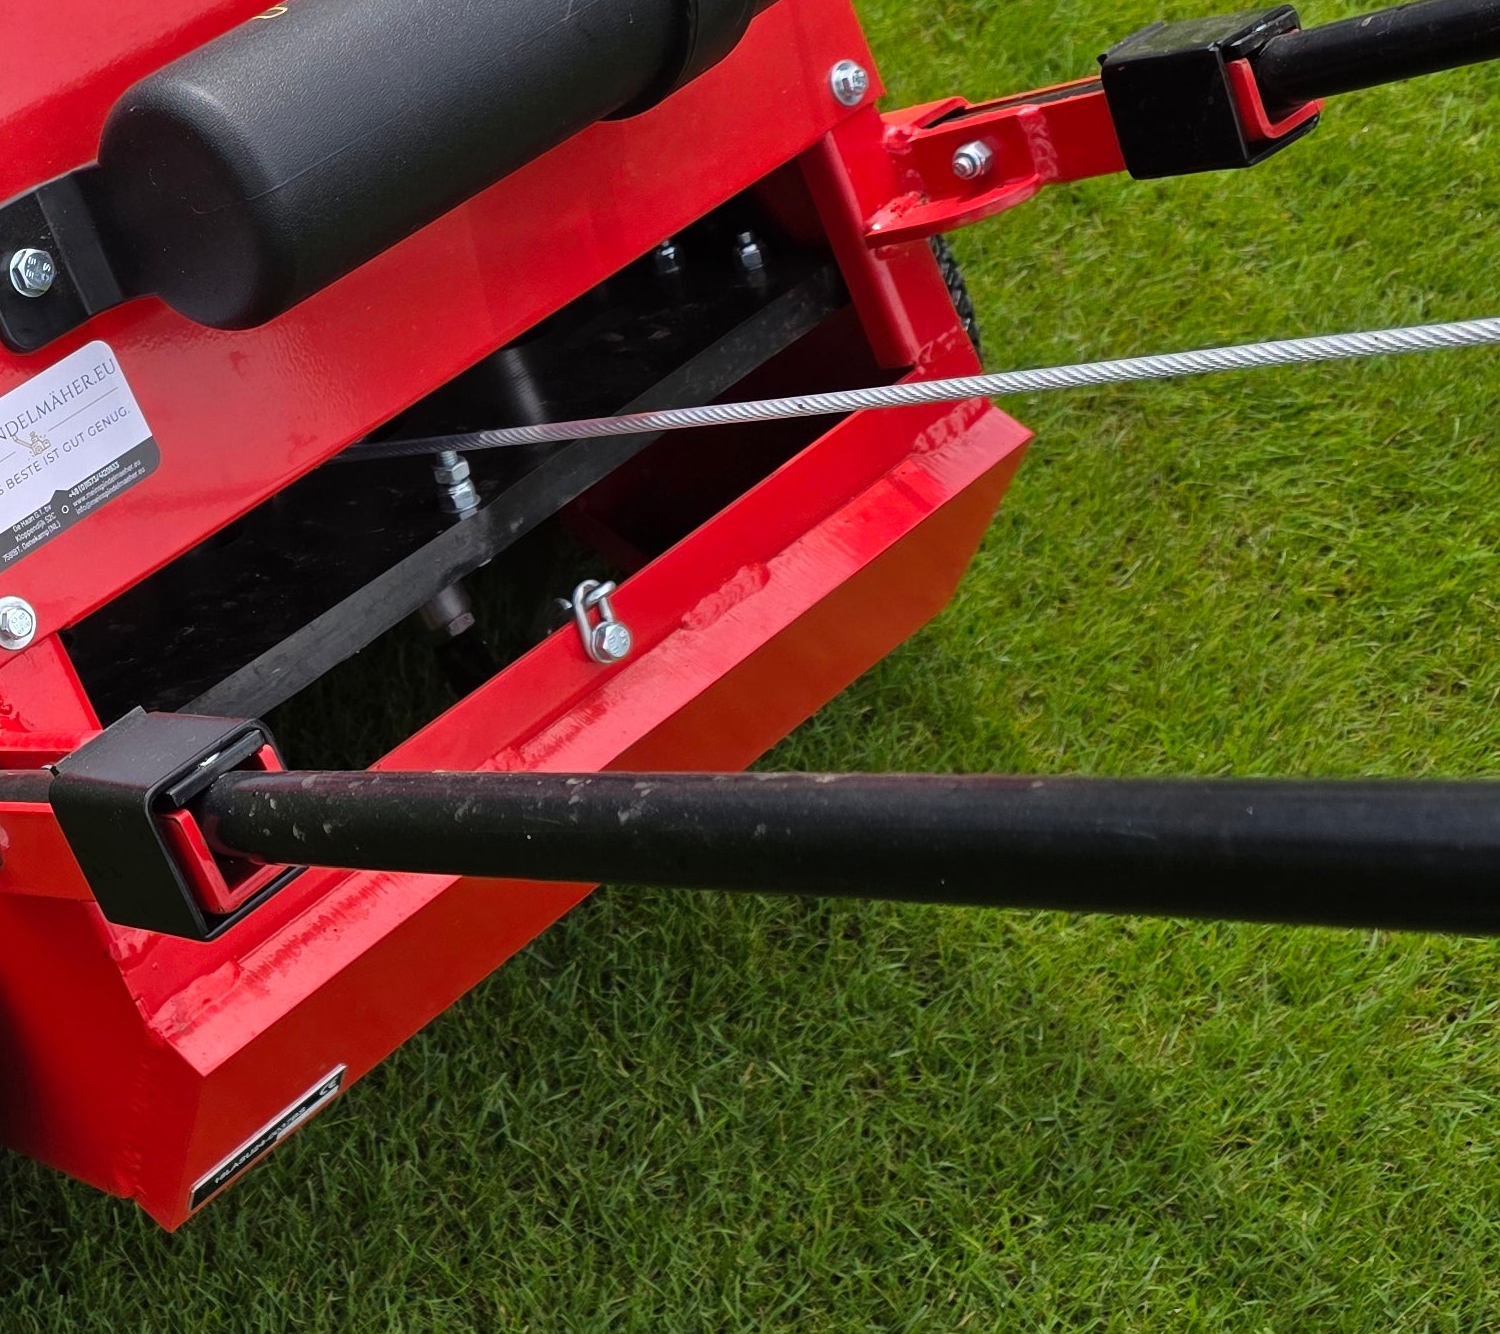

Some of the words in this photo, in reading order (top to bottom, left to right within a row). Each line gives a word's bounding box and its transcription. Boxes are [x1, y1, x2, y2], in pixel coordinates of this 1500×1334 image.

[6, 459, 41, 489] BESTE
[43, 449, 61, 466] IST
[63, 432, 86, 453] GUT
[87, 406, 131, 438] GENUG.
